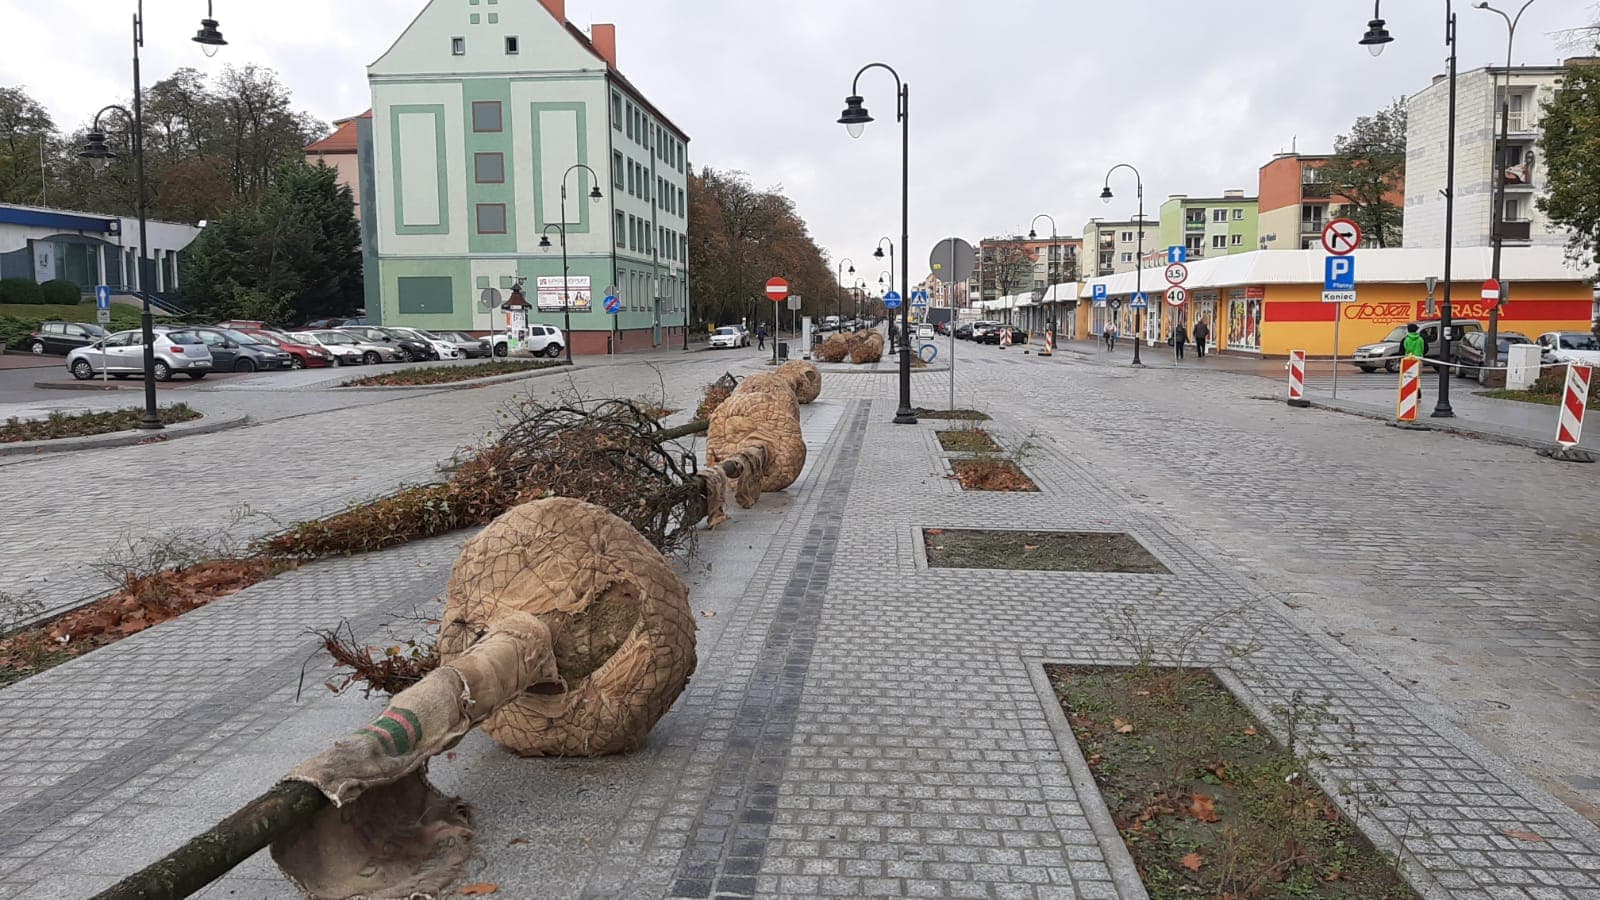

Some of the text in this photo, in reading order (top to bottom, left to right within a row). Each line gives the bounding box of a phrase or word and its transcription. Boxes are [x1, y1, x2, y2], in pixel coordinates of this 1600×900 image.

[1331, 258, 1349, 281] P
[1095, 286, 1104, 296] P
[1168, 290, 1184, 301] 40
